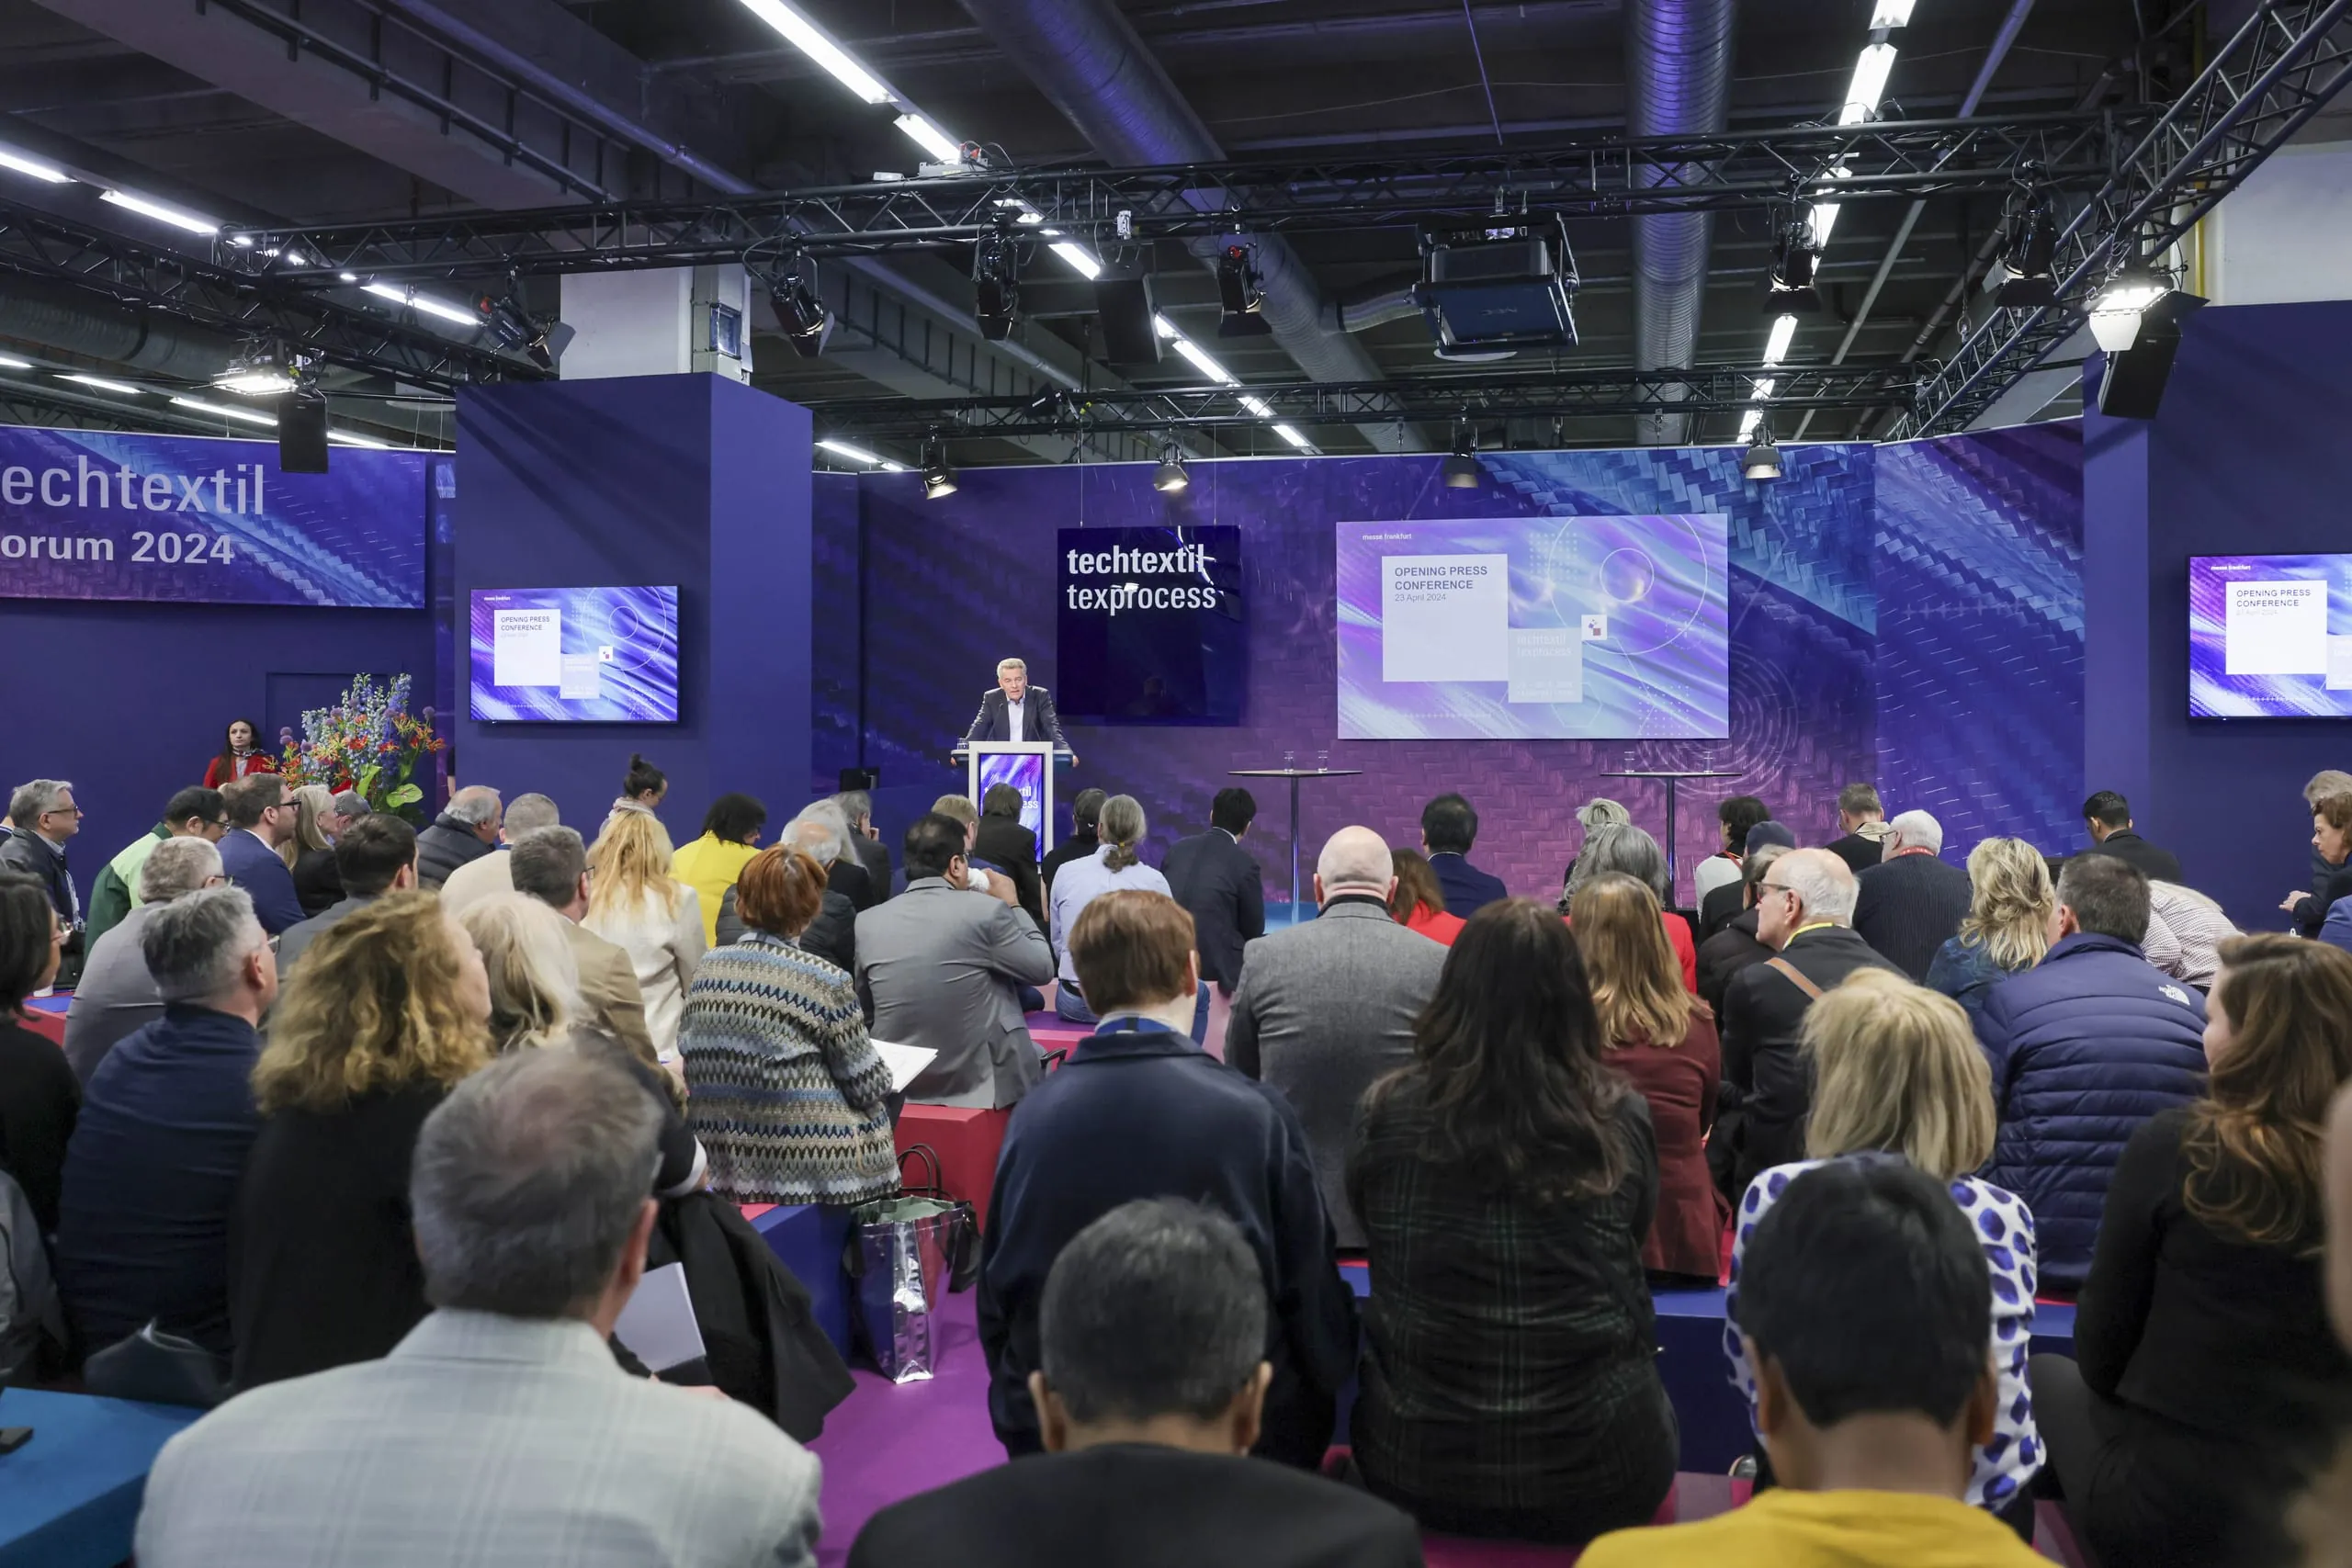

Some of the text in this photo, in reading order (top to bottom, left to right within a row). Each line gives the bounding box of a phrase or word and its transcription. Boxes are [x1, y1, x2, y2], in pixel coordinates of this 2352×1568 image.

[1, 455, 264, 515] echtextil
[0, 530, 236, 566] orum 2024
[1067, 544, 1204, 575] techtextil
[1395, 565, 1488, 577] OPENING PRESS
[1395, 580, 1474, 591] CONFERENCE
[1395, 592, 1447, 604] 23 April 2024
[2236, 588, 2312, 598] OPENING PRESS
[1067, 583, 1216, 616] texprocess
[2236, 599, 2300, 608] CONFERENCE
